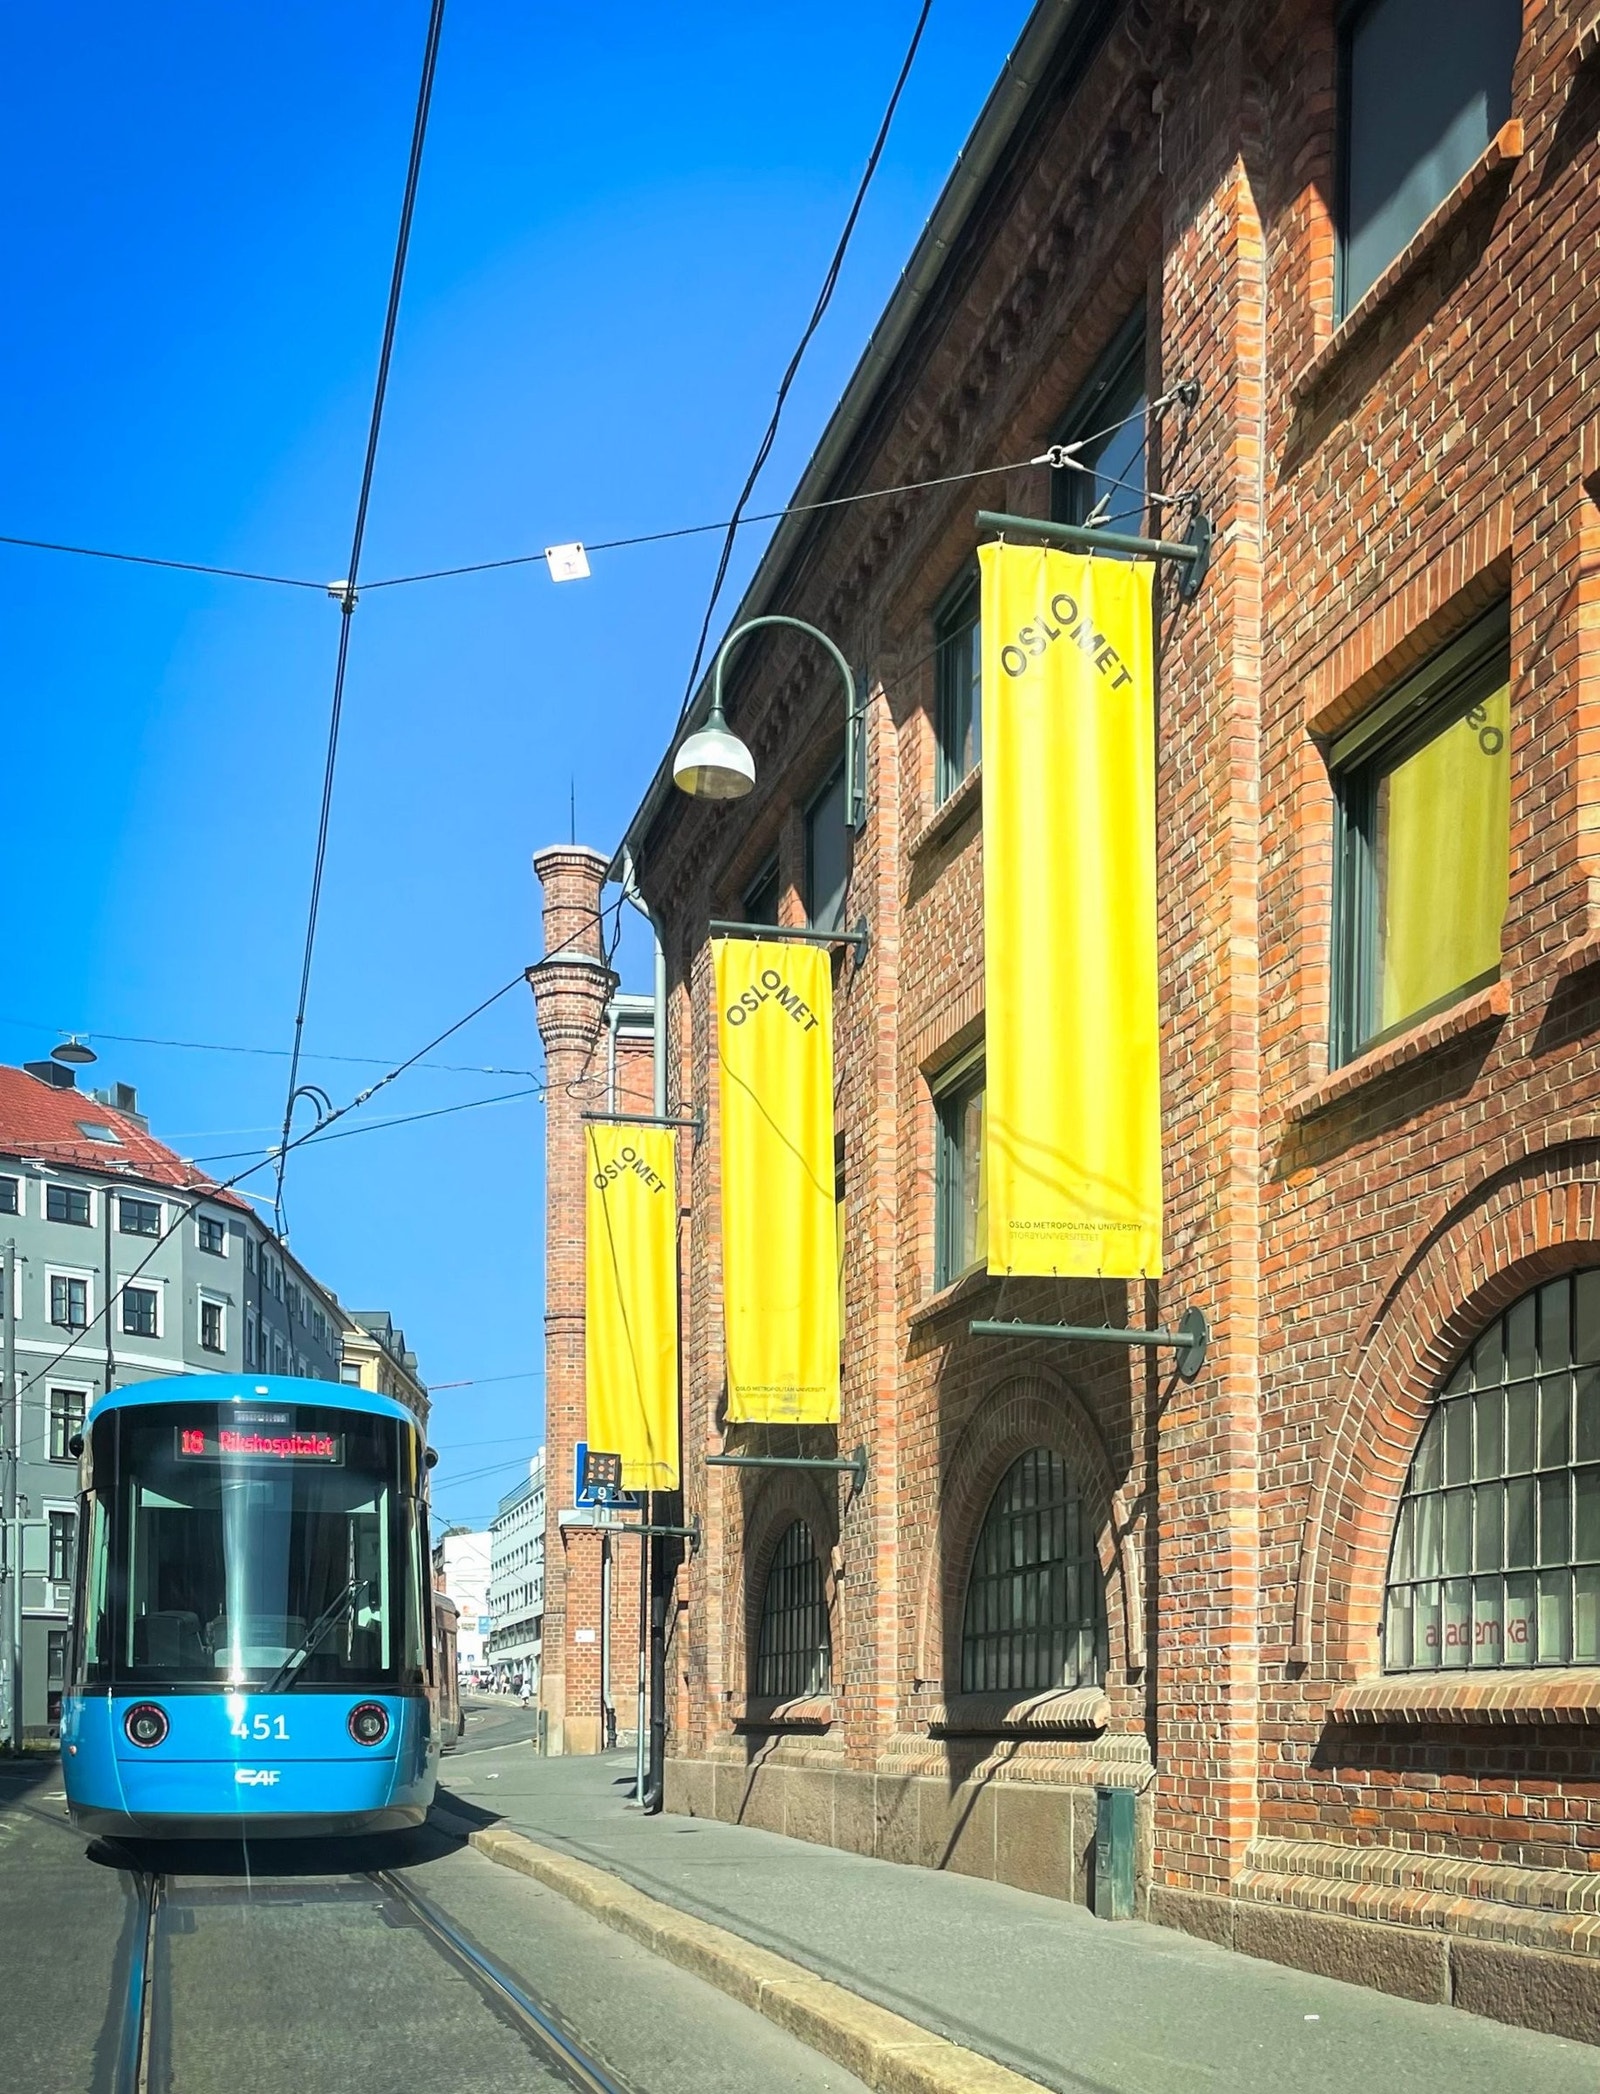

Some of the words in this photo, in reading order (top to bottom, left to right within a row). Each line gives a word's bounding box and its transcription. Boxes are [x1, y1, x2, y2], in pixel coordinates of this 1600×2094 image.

[1001, 594, 1133, 690] OSLOMET
[726, 970, 819, 1032] OSLOMET
[593, 1147, 666, 1194] OSLOMET
[1009, 1221, 1031, 1230] OSLO
[1033, 1222, 1096, 1231] METROPOLITAN
[1098, 1223, 1142, 1233] UNIVERSITY
[181, 1430, 205, 1454] 18
[219, 1430, 333, 1458] Rikshospitalet
[597, 1486, 607, 1500] 9
[230, 1713, 291, 1740] 451
